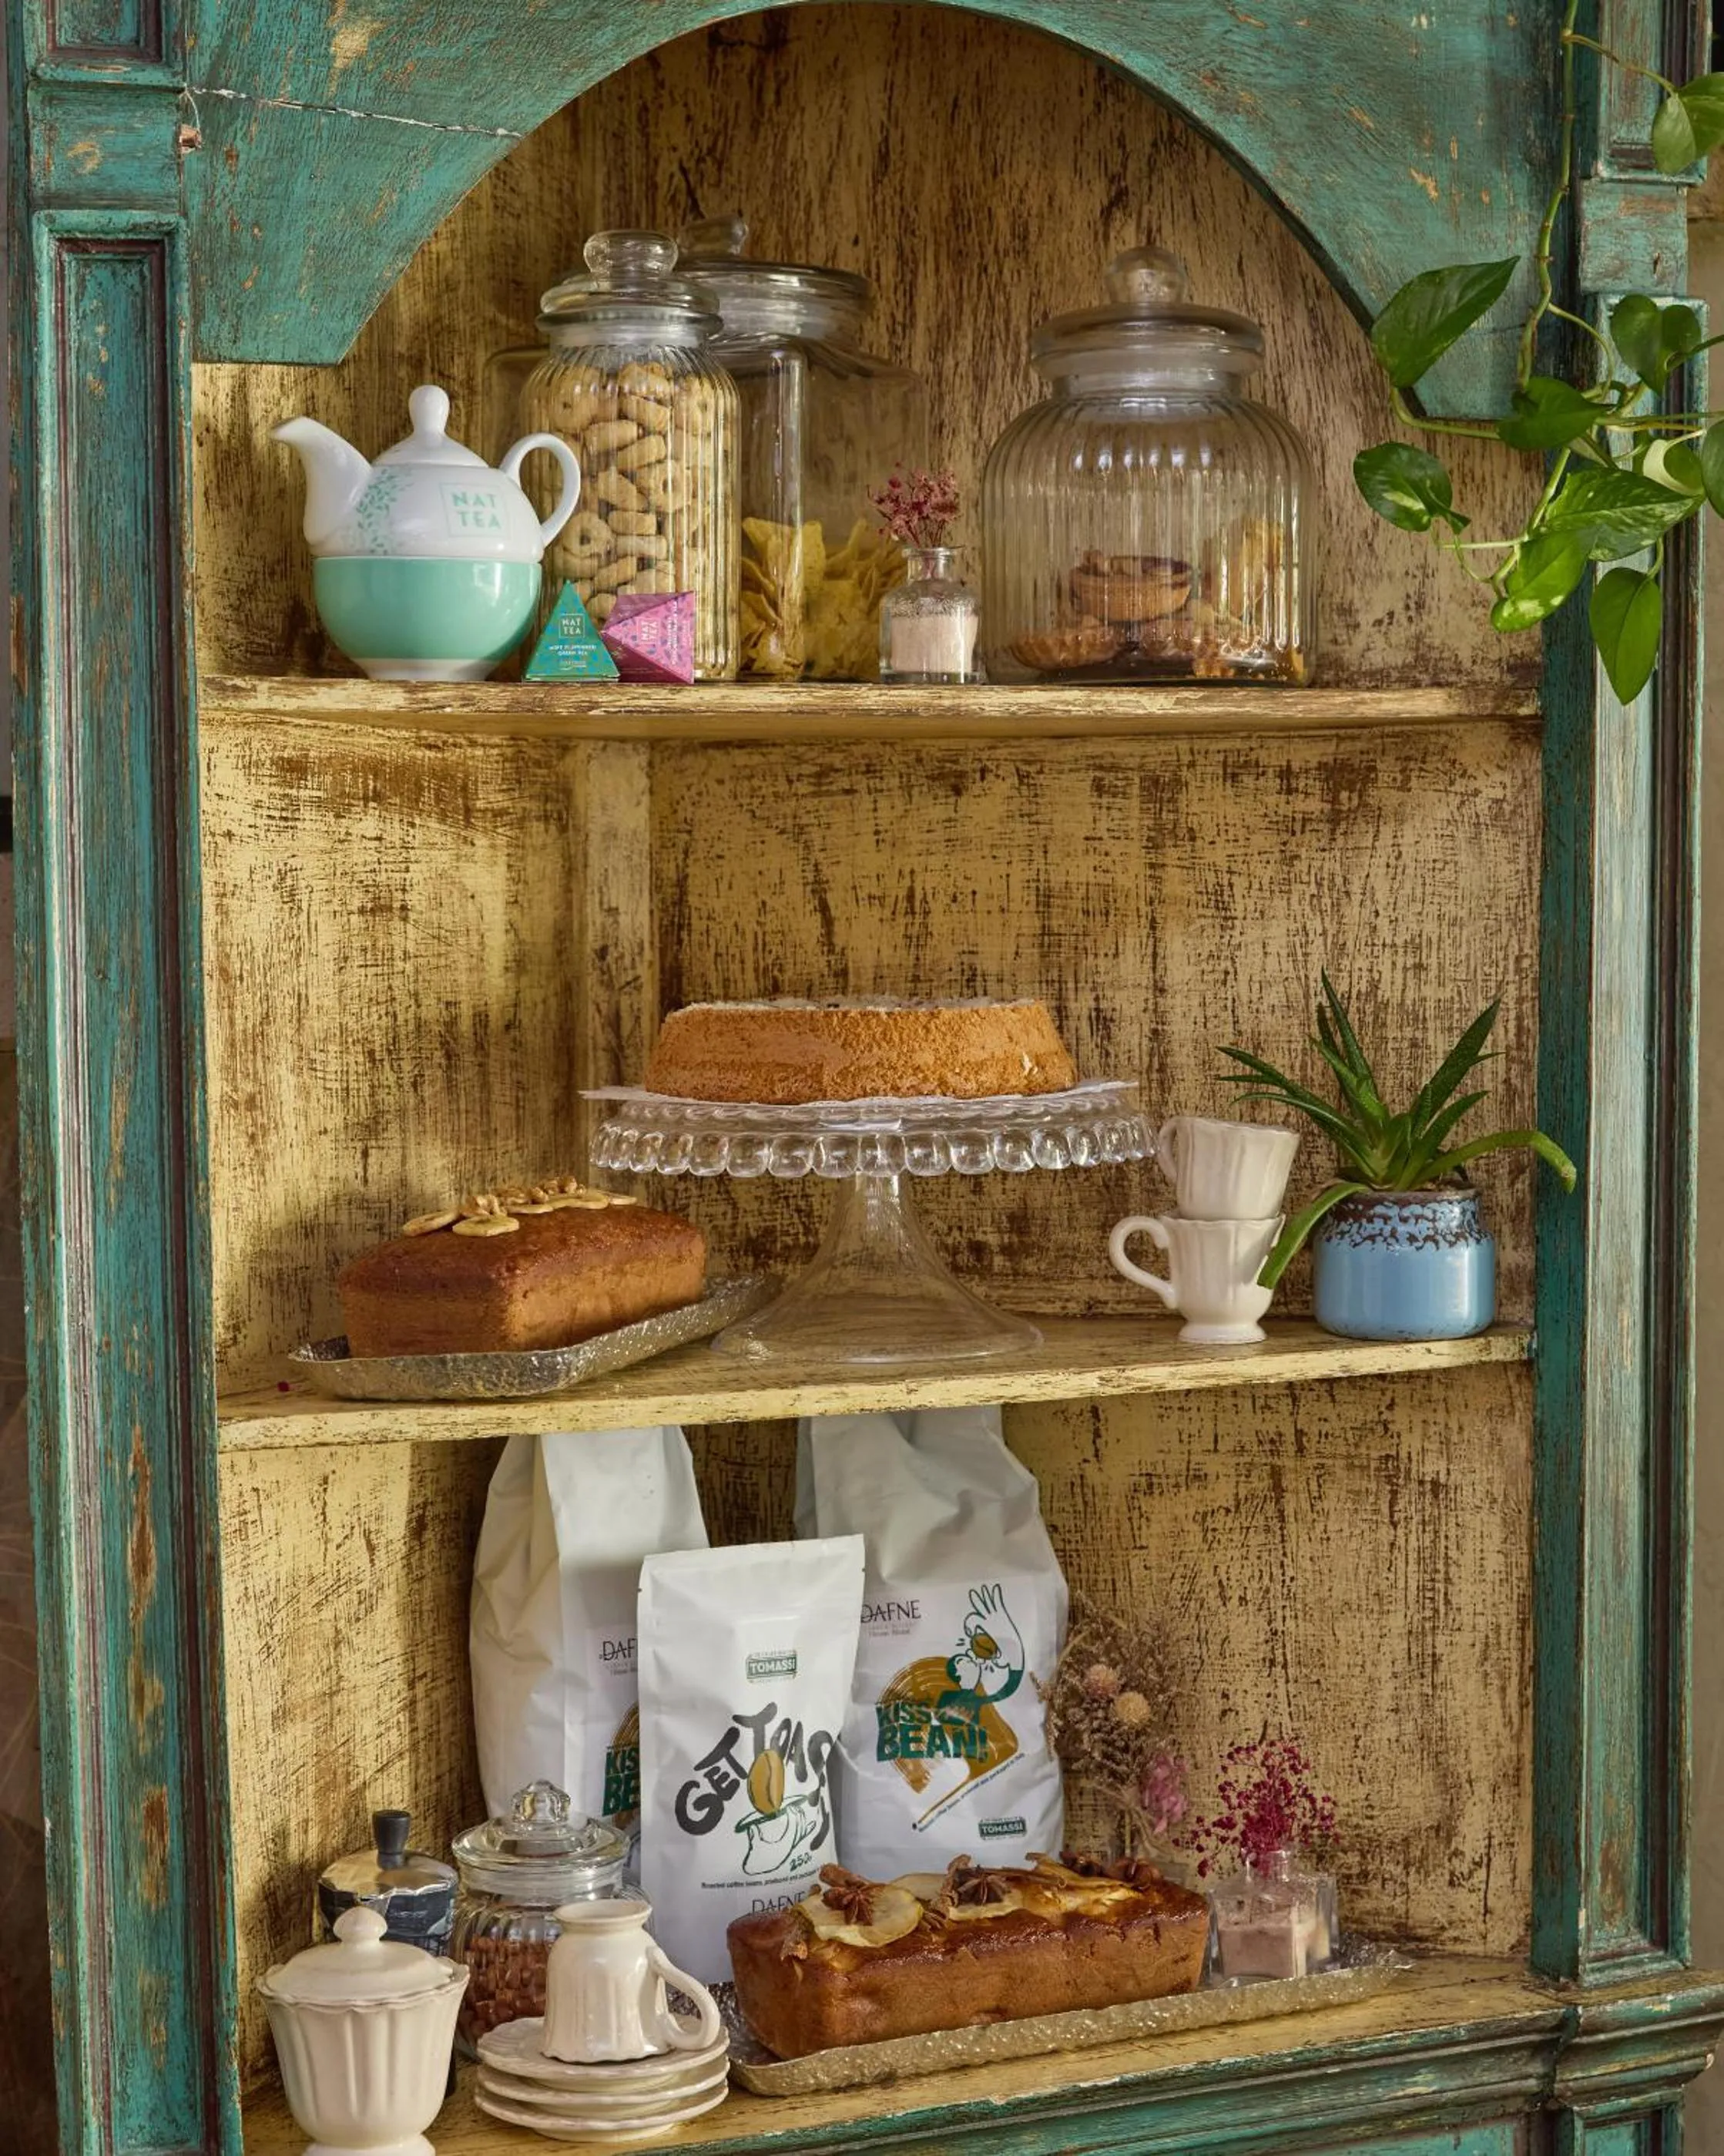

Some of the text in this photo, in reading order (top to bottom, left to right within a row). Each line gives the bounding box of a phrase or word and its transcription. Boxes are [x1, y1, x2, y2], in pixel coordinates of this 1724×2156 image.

[451, 492, 497, 509] NAT
[457, 510, 502, 529] TEA
[562, 617, 581, 626] NAT
[563, 626, 582, 635] TEA
[860, 1600, 921, 1624] DAFNE
[602, 1637, 638, 1661] DAF
[750, 1657, 796, 1674] TOMASSI
[877, 1722, 988, 1762] BEAN!
[675, 1726, 748, 1835] GET
[981, 1822, 1024, 1834] TOMASSI
